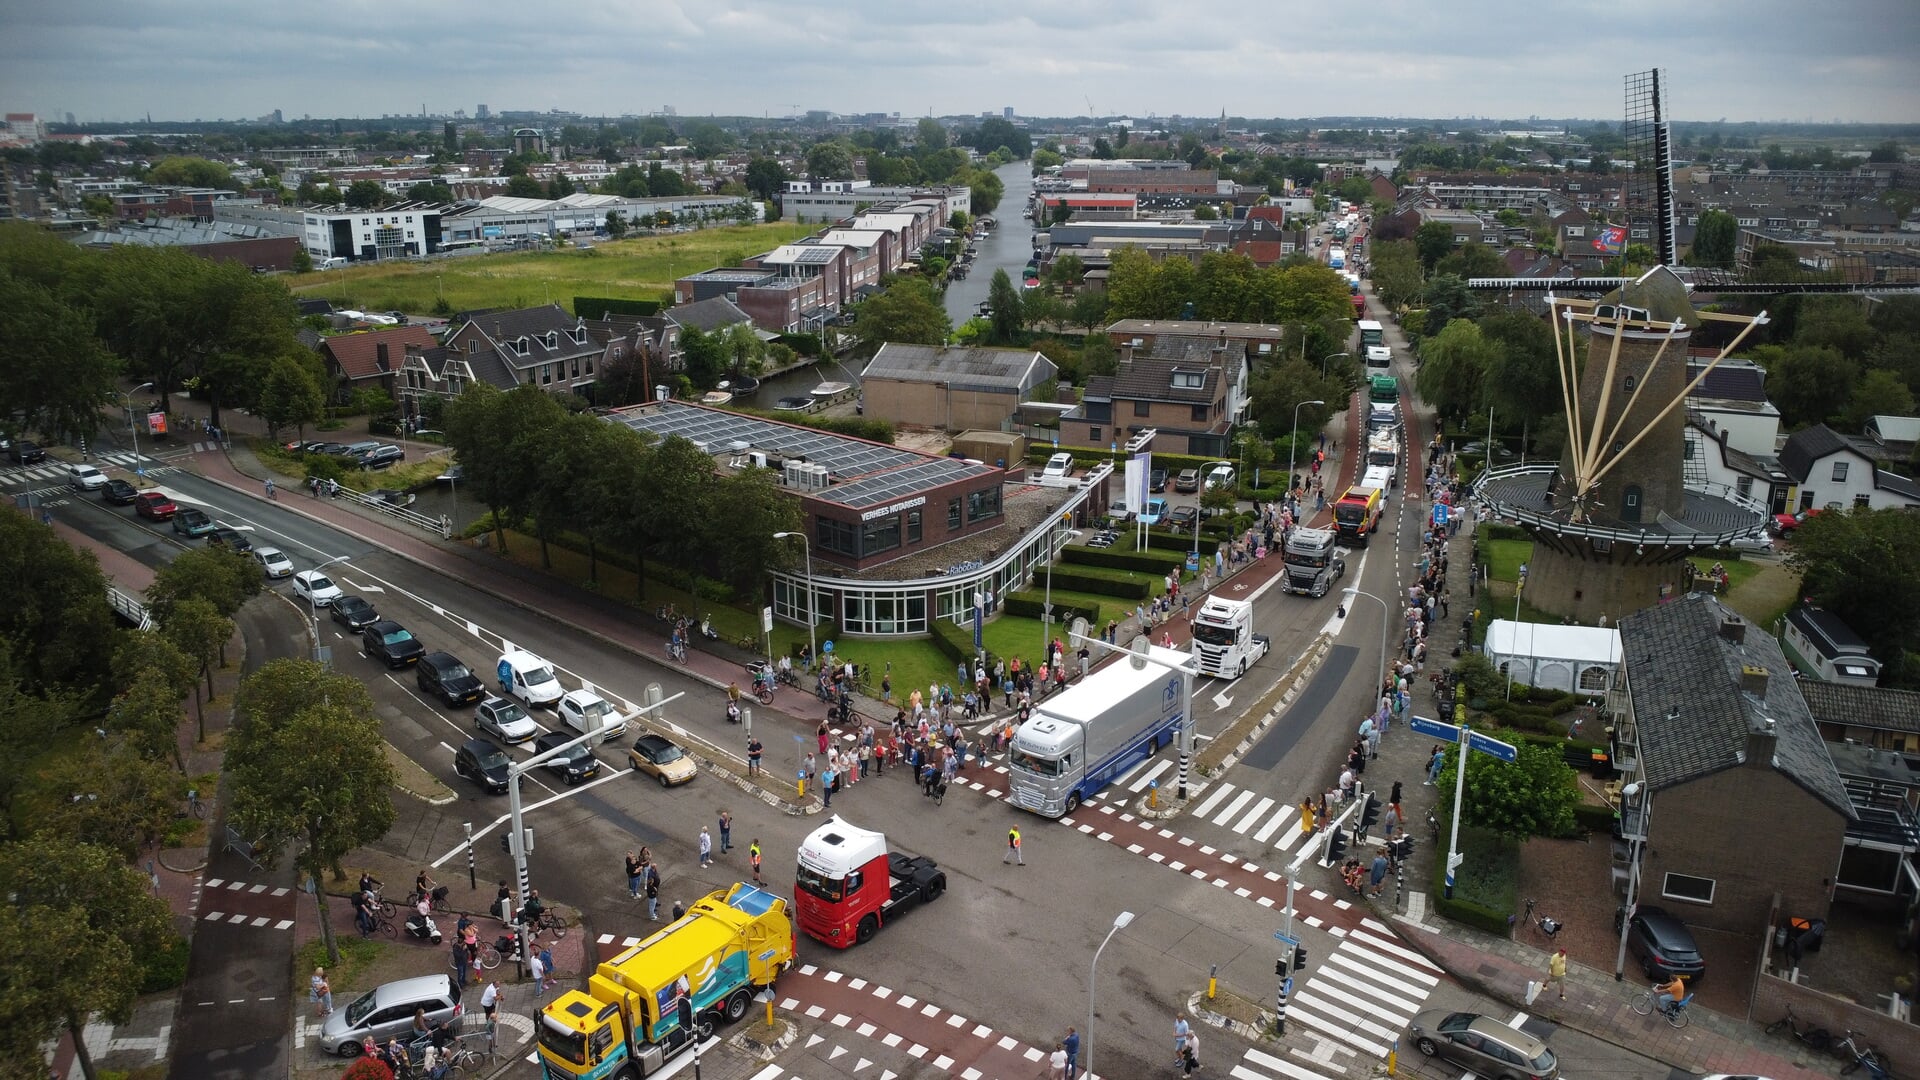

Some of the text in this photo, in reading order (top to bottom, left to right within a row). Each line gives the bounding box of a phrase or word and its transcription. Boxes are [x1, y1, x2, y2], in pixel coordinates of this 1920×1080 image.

[861, 496, 926, 521] VERHEES NOTARISSEN
[950, 558, 984, 576] Rabobank
